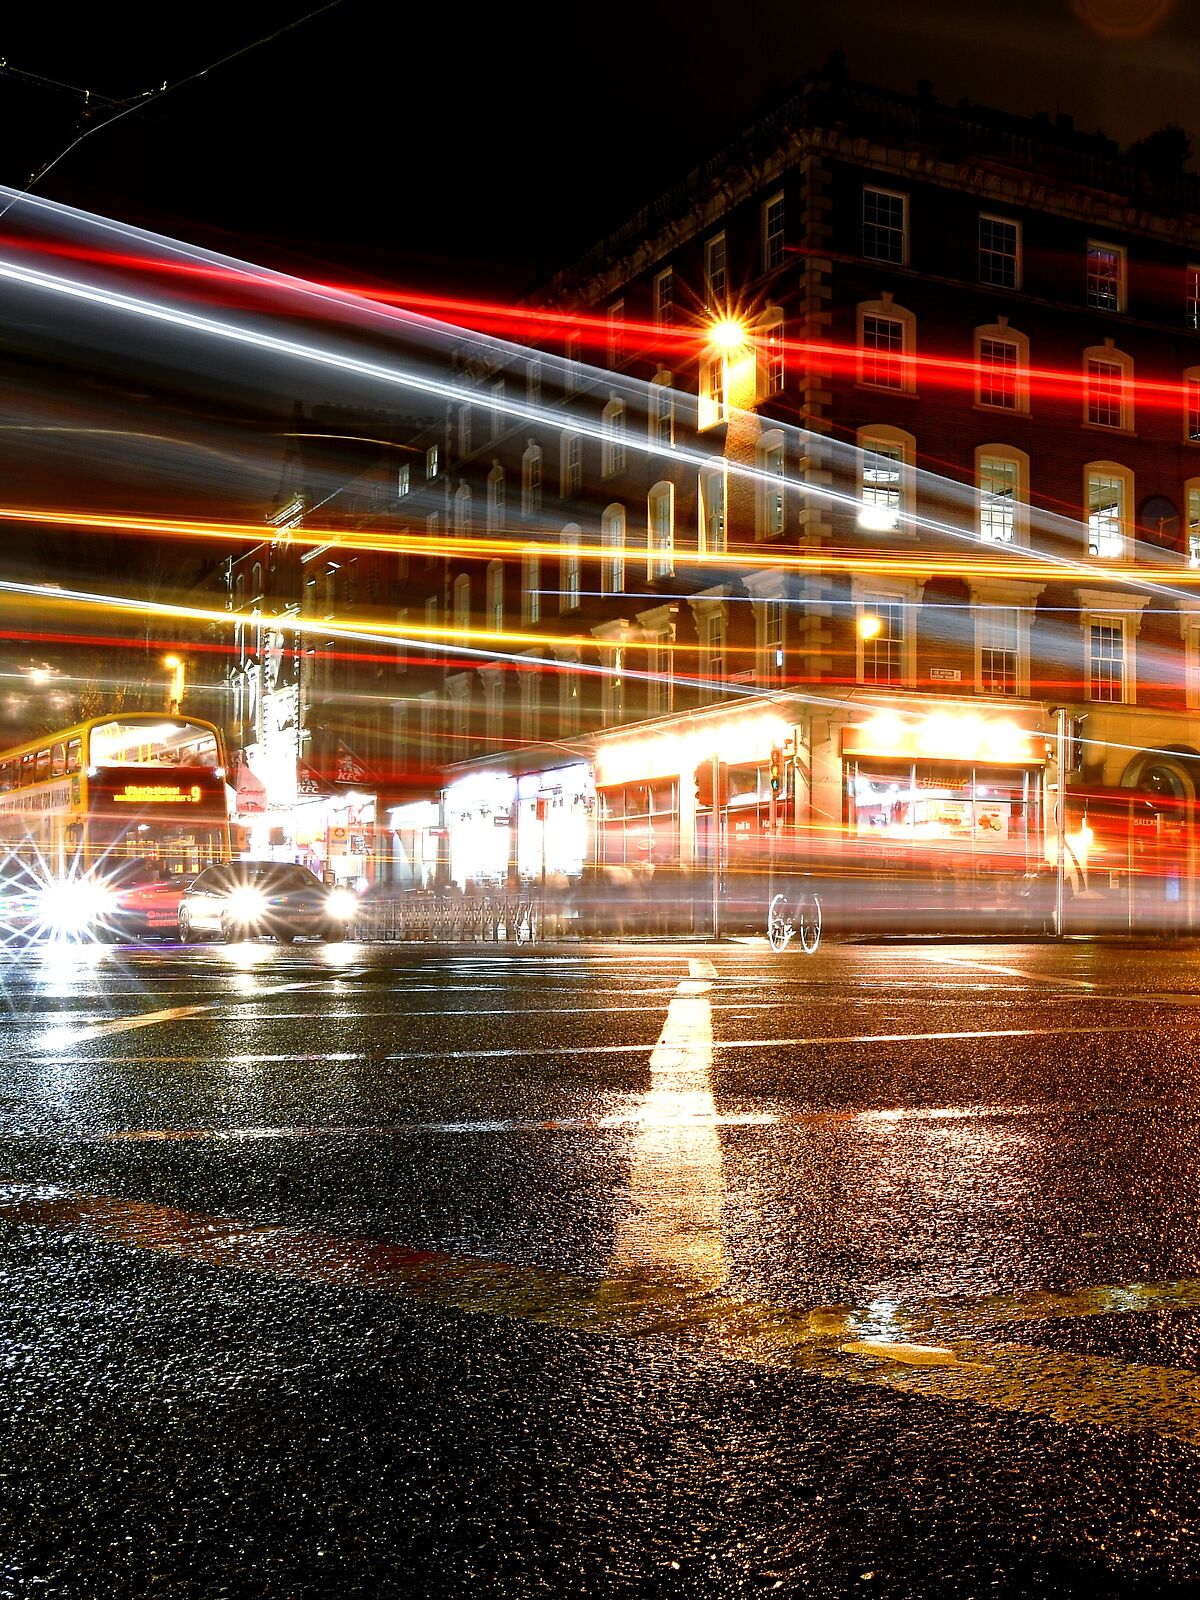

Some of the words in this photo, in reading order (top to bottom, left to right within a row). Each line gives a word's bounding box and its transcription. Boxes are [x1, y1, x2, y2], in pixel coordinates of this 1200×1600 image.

[337, 771, 361, 782] KFC
[297, 785, 320, 794] KFC
[919, 776, 969, 791] SUBWAY
[191, 786, 200, 802] 9
